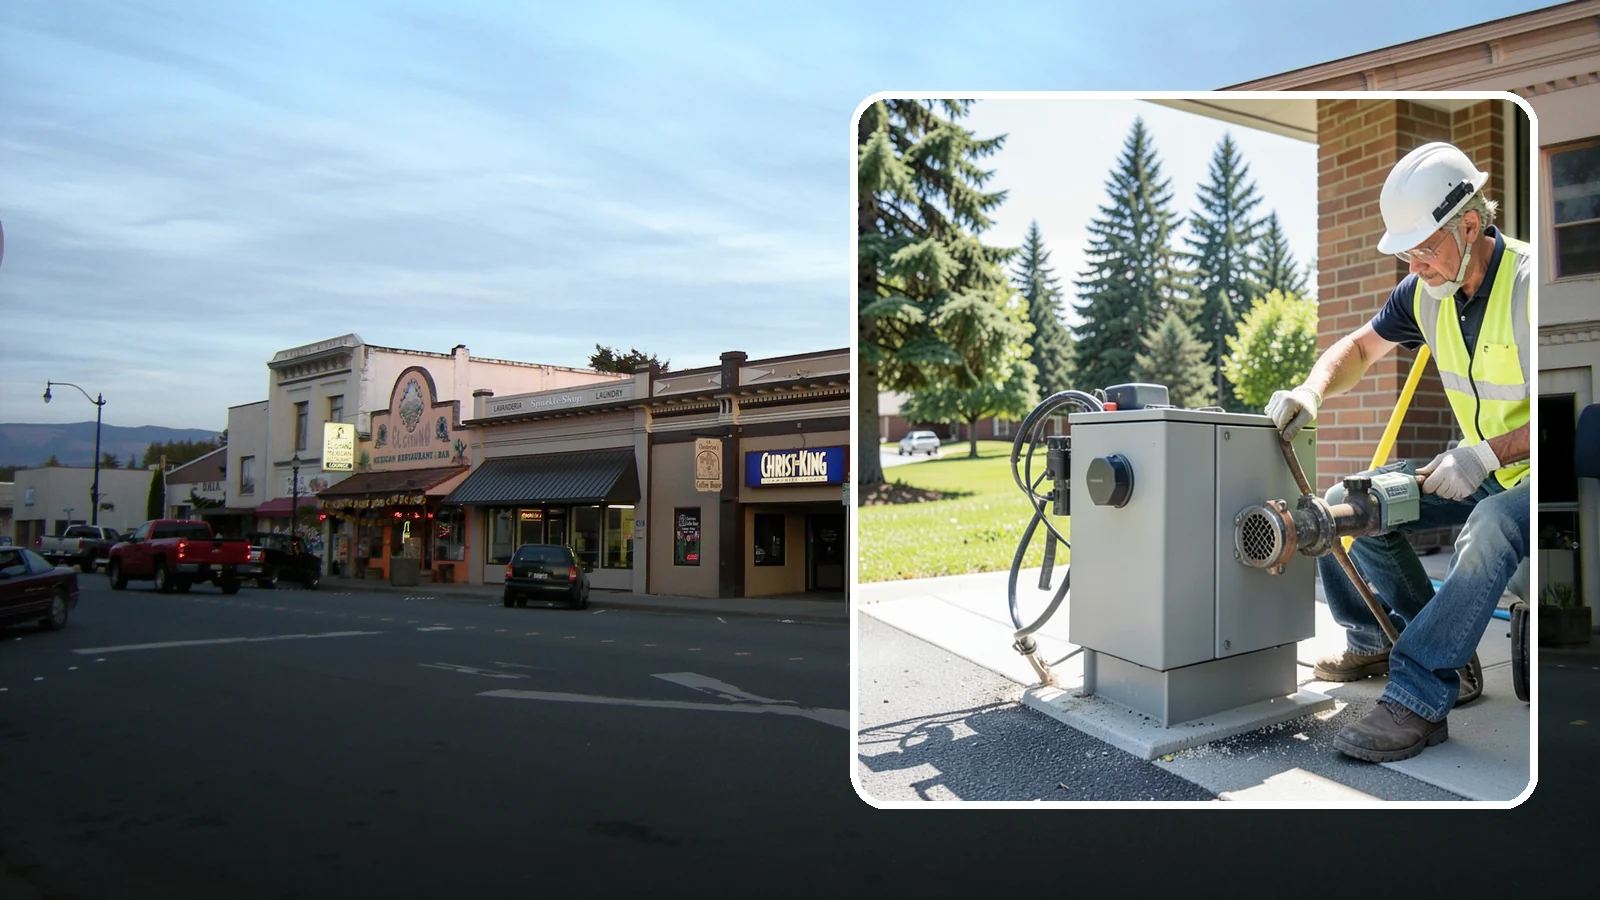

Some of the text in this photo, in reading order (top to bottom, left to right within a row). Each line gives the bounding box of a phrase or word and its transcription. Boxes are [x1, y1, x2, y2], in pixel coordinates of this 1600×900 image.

[531, 394, 583, 409] Sparkle Shop
[595, 389, 624, 400] LAUNDRY
[493, 402, 523, 413] LAVANDERIA
[373, 454, 397, 464] MEXICAN
[397, 451, 433, 462] RESTAURANT
[437, 450, 451, 459] BAR
[760, 450, 828, 478] CHRIST KING
